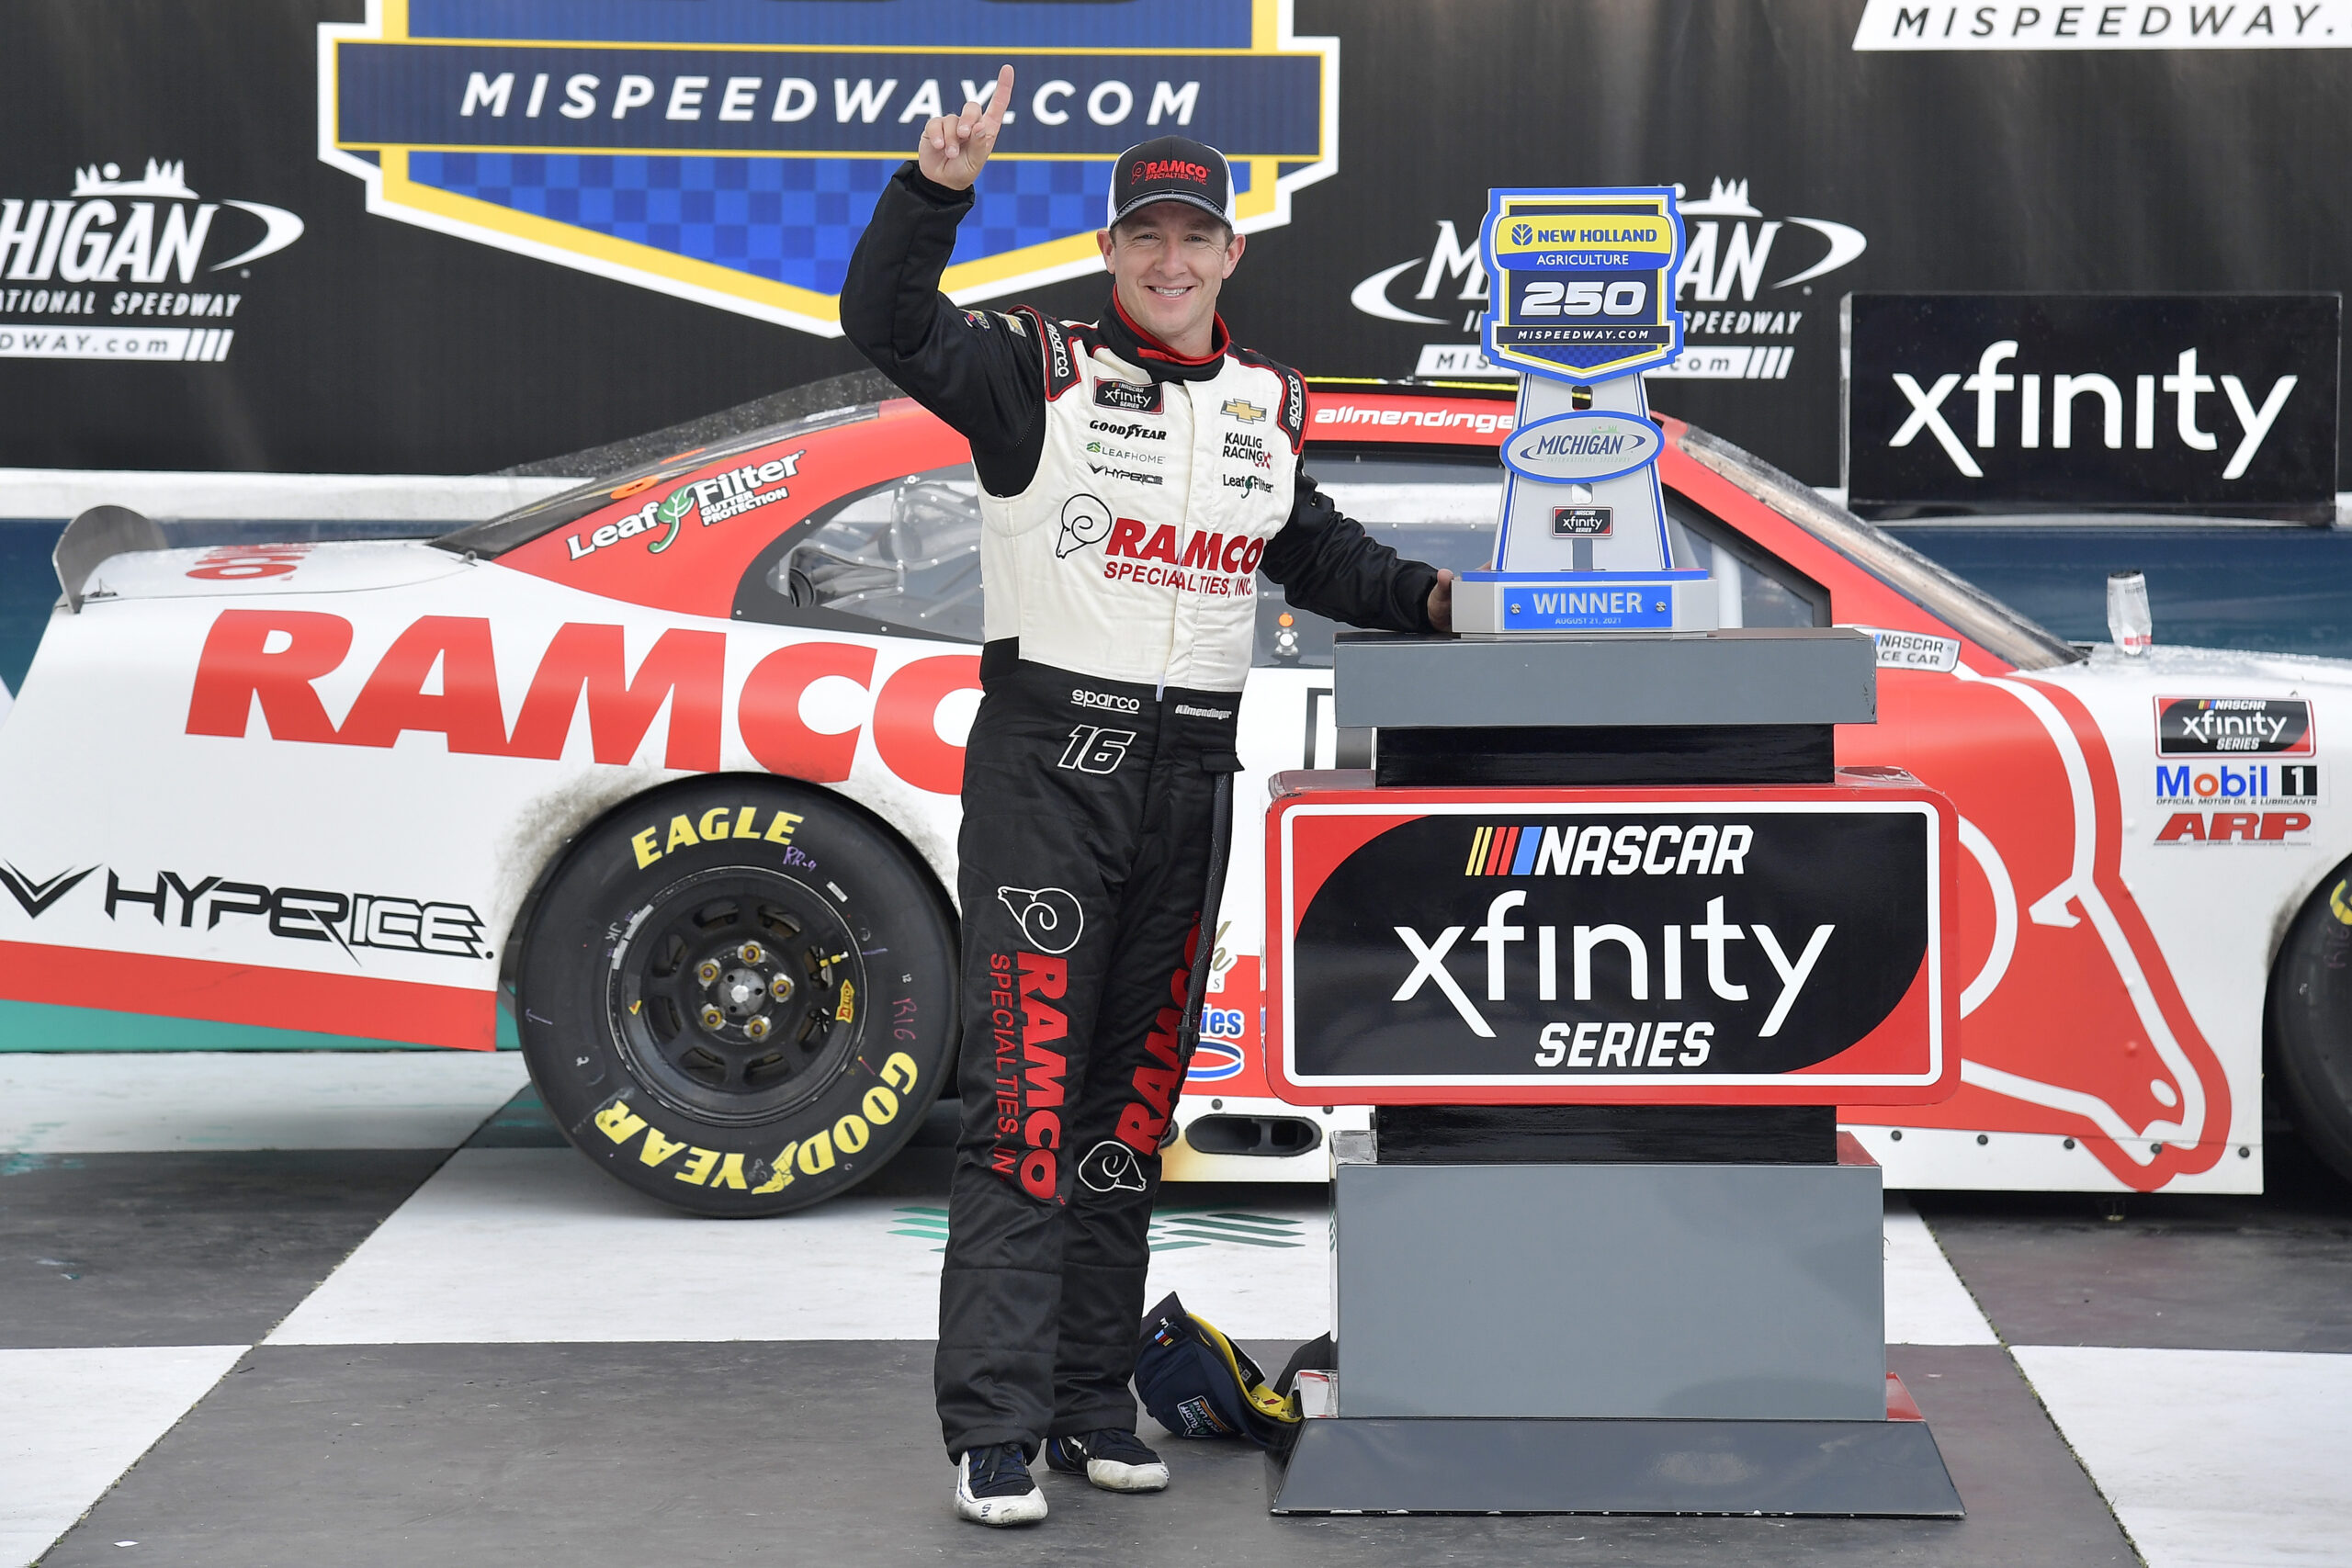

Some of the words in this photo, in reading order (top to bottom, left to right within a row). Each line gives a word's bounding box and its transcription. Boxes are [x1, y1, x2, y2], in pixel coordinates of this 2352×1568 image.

[1892, 5, 2352, 38] MISPEEDWAY.
[1146, 159, 1207, 179] RAMCO
[1537, 230, 1576, 243] NEW
[1579, 229, 1657, 243] HOLLAND
[1536, 254, 1629, 265] AGRICULTURE
[0, 288, 96, 314] TIONAL
[110, 290, 242, 317] SPEEDWAY
[1520, 281, 1647, 316] 250
[1046, 321, 1070, 378] sparco
[1517, 330, 1649, 340] MISPEEDWAY.COM
[1104, 388, 1152, 408] xfinity
[1287, 374, 1303, 430] sparco
[1888, 339, 2299, 479] xfinity
[1089, 420, 1168, 440] GOODYEAR
[1225, 432, 1263, 449] KAULIG
[1222, 445, 1264, 463] RACING
[1535, 434, 1625, 456] MICHIGAN
[700, 490, 754, 516] GUTTER
[702, 487, 789, 526] PROTECTION
[1562, 515, 1603, 530] xfinity
[1104, 516, 1264, 575] RAMCO
[1103, 560, 1233, 599] SPECIALTIES,
[1532, 592, 1644, 615] WINNER
[1555, 617, 1588, 626] AUGUST
[1589, 617, 1601, 626] 21,
[1880, 634, 1944, 653] NASCAR
[1906, 652, 1940, 665] CAR
[185, 608, 985, 796] RAMCO
[1070, 689, 1140, 715] sparco
[2214, 699, 2267, 711] NASCAR
[2182, 710, 2288, 744] xfinity
[1057, 724, 1137, 774] 16
[2216, 737, 2260, 750] SERIES
[2155, 765, 2268, 797] Mobil
[2260, 798, 2317, 807] LUBRICANTS
[630, 806, 804, 870] EAGLE
[2154, 812, 2312, 841] ARP
[1534, 825, 1755, 876] NASCAR
[604, 921, 623, 942] JK
[1390, 889, 1837, 1039] xfinity
[892, 997, 917, 1041] R16
[989, 953, 1020, 1140] SPECIALTIES,
[1533, 1021, 1716, 1068] SERIES
[1016, 950, 1069, 1200] RAMCO
